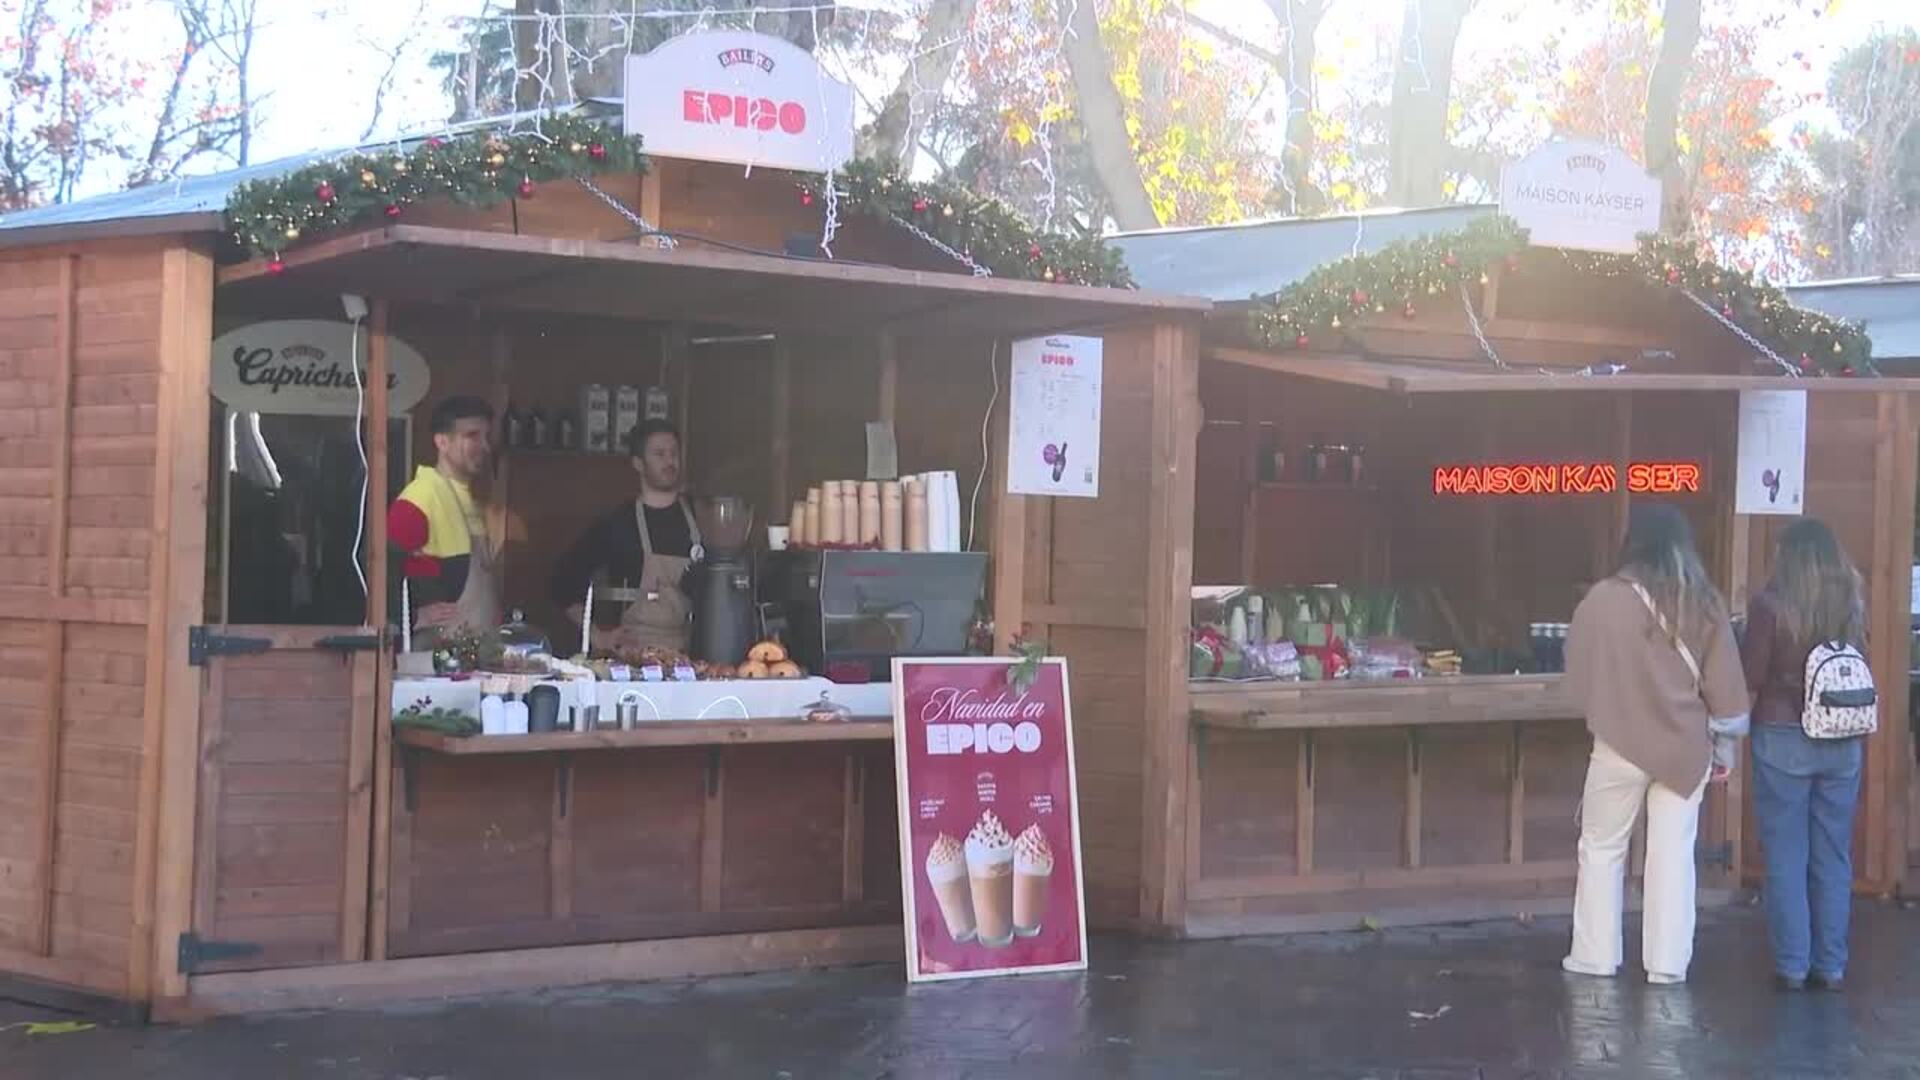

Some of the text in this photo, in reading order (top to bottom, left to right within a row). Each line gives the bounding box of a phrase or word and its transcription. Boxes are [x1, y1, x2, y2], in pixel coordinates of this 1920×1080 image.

[683, 90, 806, 134] EPICO
[1516, 186, 1644, 212] MAISON KAYSER
[1435, 466, 1556, 494] MAISON
[921, 687, 1046, 722] Navidad en
[926, 721, 1042, 755] EPICO
